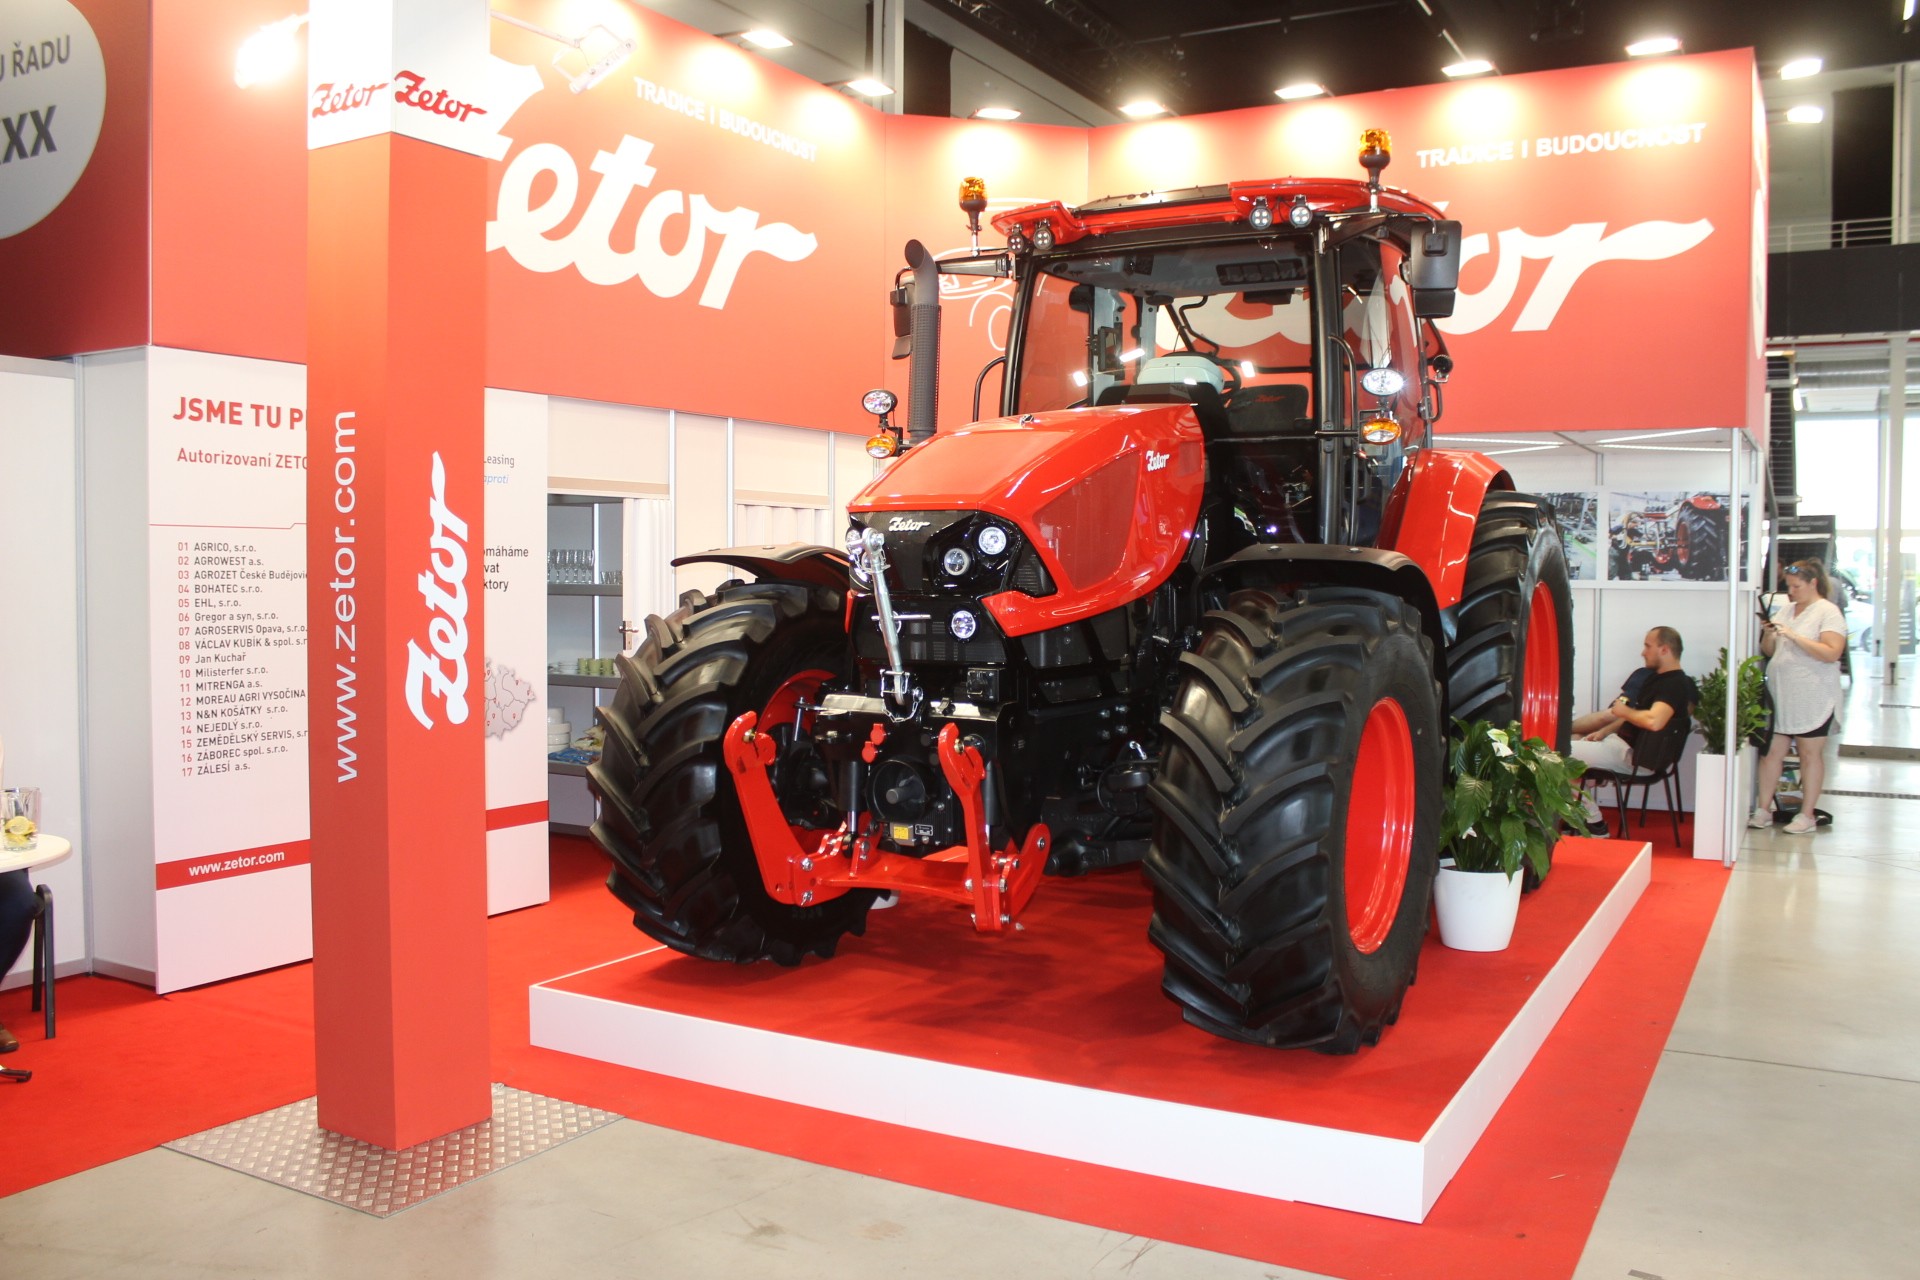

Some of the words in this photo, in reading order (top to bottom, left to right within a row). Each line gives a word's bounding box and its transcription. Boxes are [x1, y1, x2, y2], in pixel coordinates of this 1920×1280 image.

[13, 34, 71, 78] ŘADU
[312, 82, 390, 118] Zetor
[394, 70, 488, 122] Zetor
[634, 76, 706, 121] TRADICE
[709, 106, 716, 125] I
[720, 112, 817, 162] BUDOUCNOST
[0, 105, 58, 166] XX
[1416, 143, 1514, 168] TRADICE
[1522, 139, 1528, 159] I
[1535, 122, 1707, 158] BUDOUCNOST
[173, 397, 243, 425] JSME
[250, 404, 281, 428] TU
[290, 408, 307, 430] P
[177, 448, 271, 467] Autorizovaní
[1146, 449, 1171, 472] Zetor
[888, 516, 931, 532] Zetor
[178, 542, 188, 551] 01
[194, 543, 231, 552] AGRICO,
[234, 544, 256, 552] s.r.o.
[484, 545, 528, 558] máháme
[178, 557, 189, 566] 02
[194, 557, 246, 565] AGROWEST
[248, 558, 264, 566] a.s.
[178, 571, 189, 580] 03
[194, 571, 237, 579] AGROZET
[240, 568, 266, 579] České
[269, 570, 307, 581] Budějovi
[178, 585, 189, 594] 04
[194, 584, 238, 593] BOHATEC
[240, 585, 263, 593] s.r.o.
[330, 410, 358, 783] www.zetor.com
[404, 450, 470, 731] Zetor
[178, 599, 189, 608] 05
[195, 599, 216, 608] EHL,
[218, 599, 242, 607] s.r.o.
[179, 613, 189, 622] 06
[195, 613, 226, 623] Gregor
[237, 612, 254, 622] syn,
[257, 611, 278, 620] s.r.o.
[179, 627, 189, 636] 07
[195, 625, 253, 635] AGROSERVIS
[256, 625, 284, 634] Opava,
[179, 641, 190, 650] 08
[195, 638, 231, 649] VÁCLAV
[233, 637, 262, 648] KUBÍK
[264, 637, 270, 646] &
[273, 637, 293, 648] spol.
[179, 655, 190, 664] 09
[195, 655, 211, 664] Jan
[214, 652, 246, 662] Kuchař
[180, 669, 190, 678] 10
[196, 667, 244, 678] Milisterfer
[247, 666, 268, 675] s.r.o.
[180, 683, 190, 692] 11
[196, 681, 245, 691] MITRENGA
[247, 680, 262, 688] a.s.
[180, 698, 191, 707] 12
[196, 695, 236, 706] MOREAU
[239, 692, 260, 702] AGRI
[262, 688, 306, 700] VYSOČINA
[181, 712, 191, 721] 13
[197, 709, 218, 719] N&N
[221, 704, 262, 717] KOŠÁTKY
[267, 705, 288, 713] s.r.o.
[181, 726, 191, 735] 14
[197, 719, 238, 733] NEJEDLÝ
[241, 720, 262, 729] s.r.o.
[182, 740, 192, 749] 15
[197, 732, 258, 748] ZEMĚDĚLSKÝ
[261, 730, 294, 741] SERVIS,
[182, 754, 192, 763] 16
[197, 747, 240, 762] ZÁBOREC
[243, 747, 264, 759] spol.
[267, 744, 288, 753] s.r.o.
[182, 768, 192, 777] 17
[197, 761, 230, 775] ZÁLESÍ
[235, 762, 250, 771] a.s.
[189, 852, 284, 876] www.zetor.com
